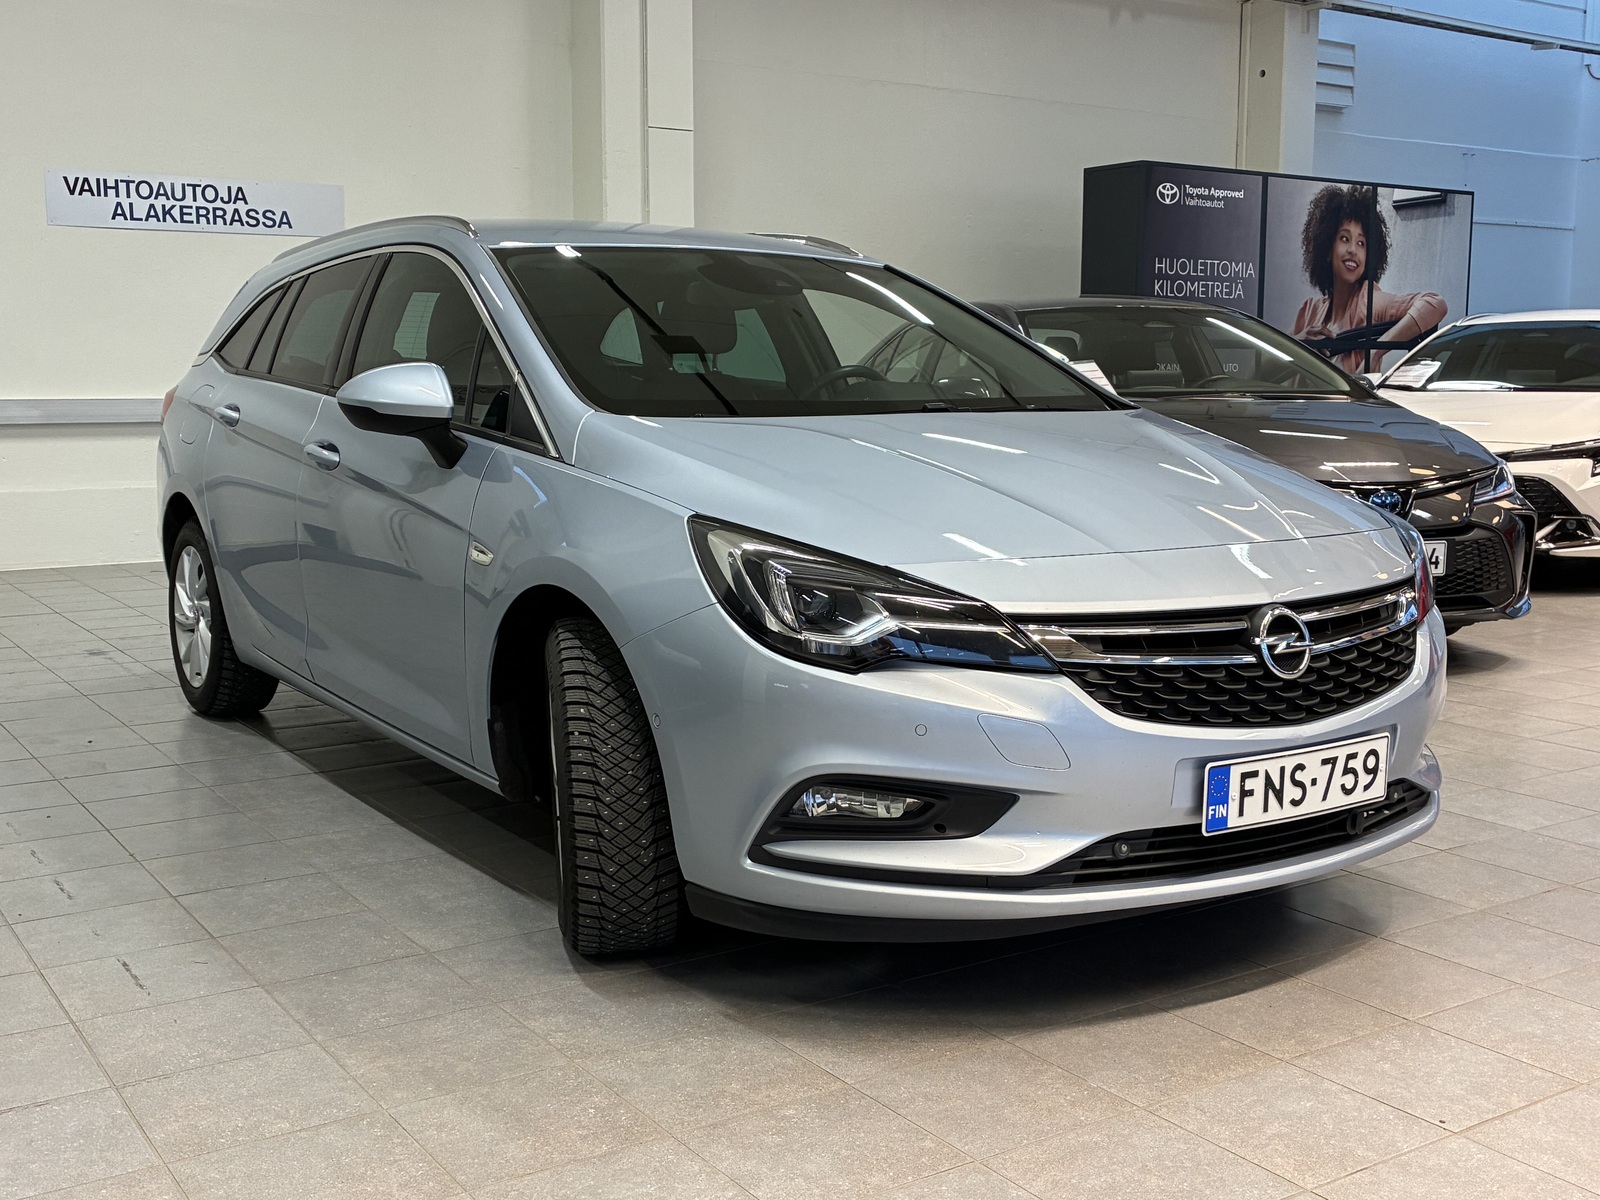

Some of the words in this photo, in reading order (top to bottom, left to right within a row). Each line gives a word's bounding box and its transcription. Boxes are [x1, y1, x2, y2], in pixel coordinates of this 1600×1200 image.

[62, 175, 249, 205] VAIHTOAUTOJA
[1185, 184, 1209, 197] Toyota
[1209, 186, 1245, 199] Approved
[1184, 196, 1225, 209] Vaihtoautot
[110, 201, 293, 229] ALAKERRASSA
[1155, 257, 1256, 278] HUOLETTOMIA
[1154, 279, 1244, 299] KILOMETREJÄ
[1237, 748, 1380, 818] FNS-759
[1207, 803, 1228, 820] FIN
